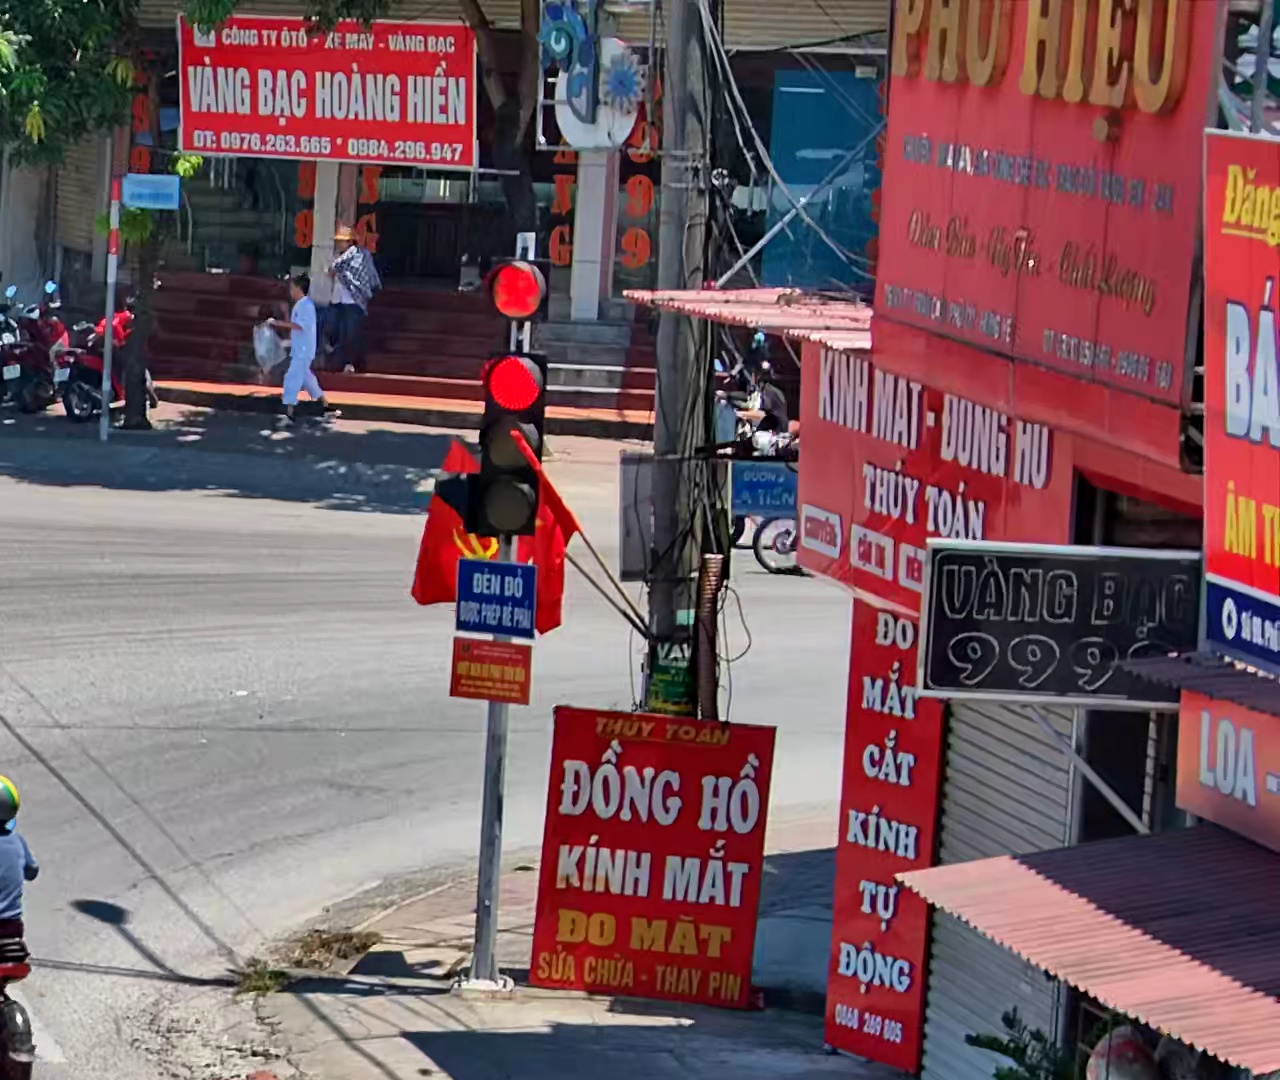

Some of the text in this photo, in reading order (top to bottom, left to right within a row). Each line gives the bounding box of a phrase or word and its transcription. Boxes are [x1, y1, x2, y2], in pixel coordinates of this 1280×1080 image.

[222, 25, 258, 46] CÔNG
[262, 29, 277, 46] TY
[281, 27, 307, 48] ÔTÔ
[324, 32, 342, 49] XE
[388, 31, 425, 52] VÀNG
[428, 36, 455, 56] BẠC
[187, 56, 251, 114] VÀNG
[258, 69, 307, 126] BẠC
[315, 62, 400, 122] HOÀNG
[220, 132, 331, 153] 0976.263.665
[348, 139, 463, 161] 0984.296.947
[863, 460, 985, 541] THÚY TOÁN
[473, 568, 523, 598] ĐÈN ĐỎ
[942, 556, 1078, 623] VÀNG
[1091, 572, 1196, 639] BẠC
[875, 612, 914, 650] ĐO
[861, 661, 918, 719] MẮT
[595, 716, 652, 738] THÚY
[862, 729, 915, 786] CẮT
[1200, 710, 1256, 807] LOA
[558, 739, 761, 834] ĐỒNG HỒ
[846, 804, 918, 861] KÍNH
[556, 835, 749, 908] KÍNH MẮT
[556, 908, 617, 947] ĐO
[859, 879, 899, 932] TỰ
[537, 944, 576, 982] SỬA
[655, 964, 702, 995] THAY
[707, 971, 742, 1001] PIN
[837, 940, 912, 994] ĐỘNG
